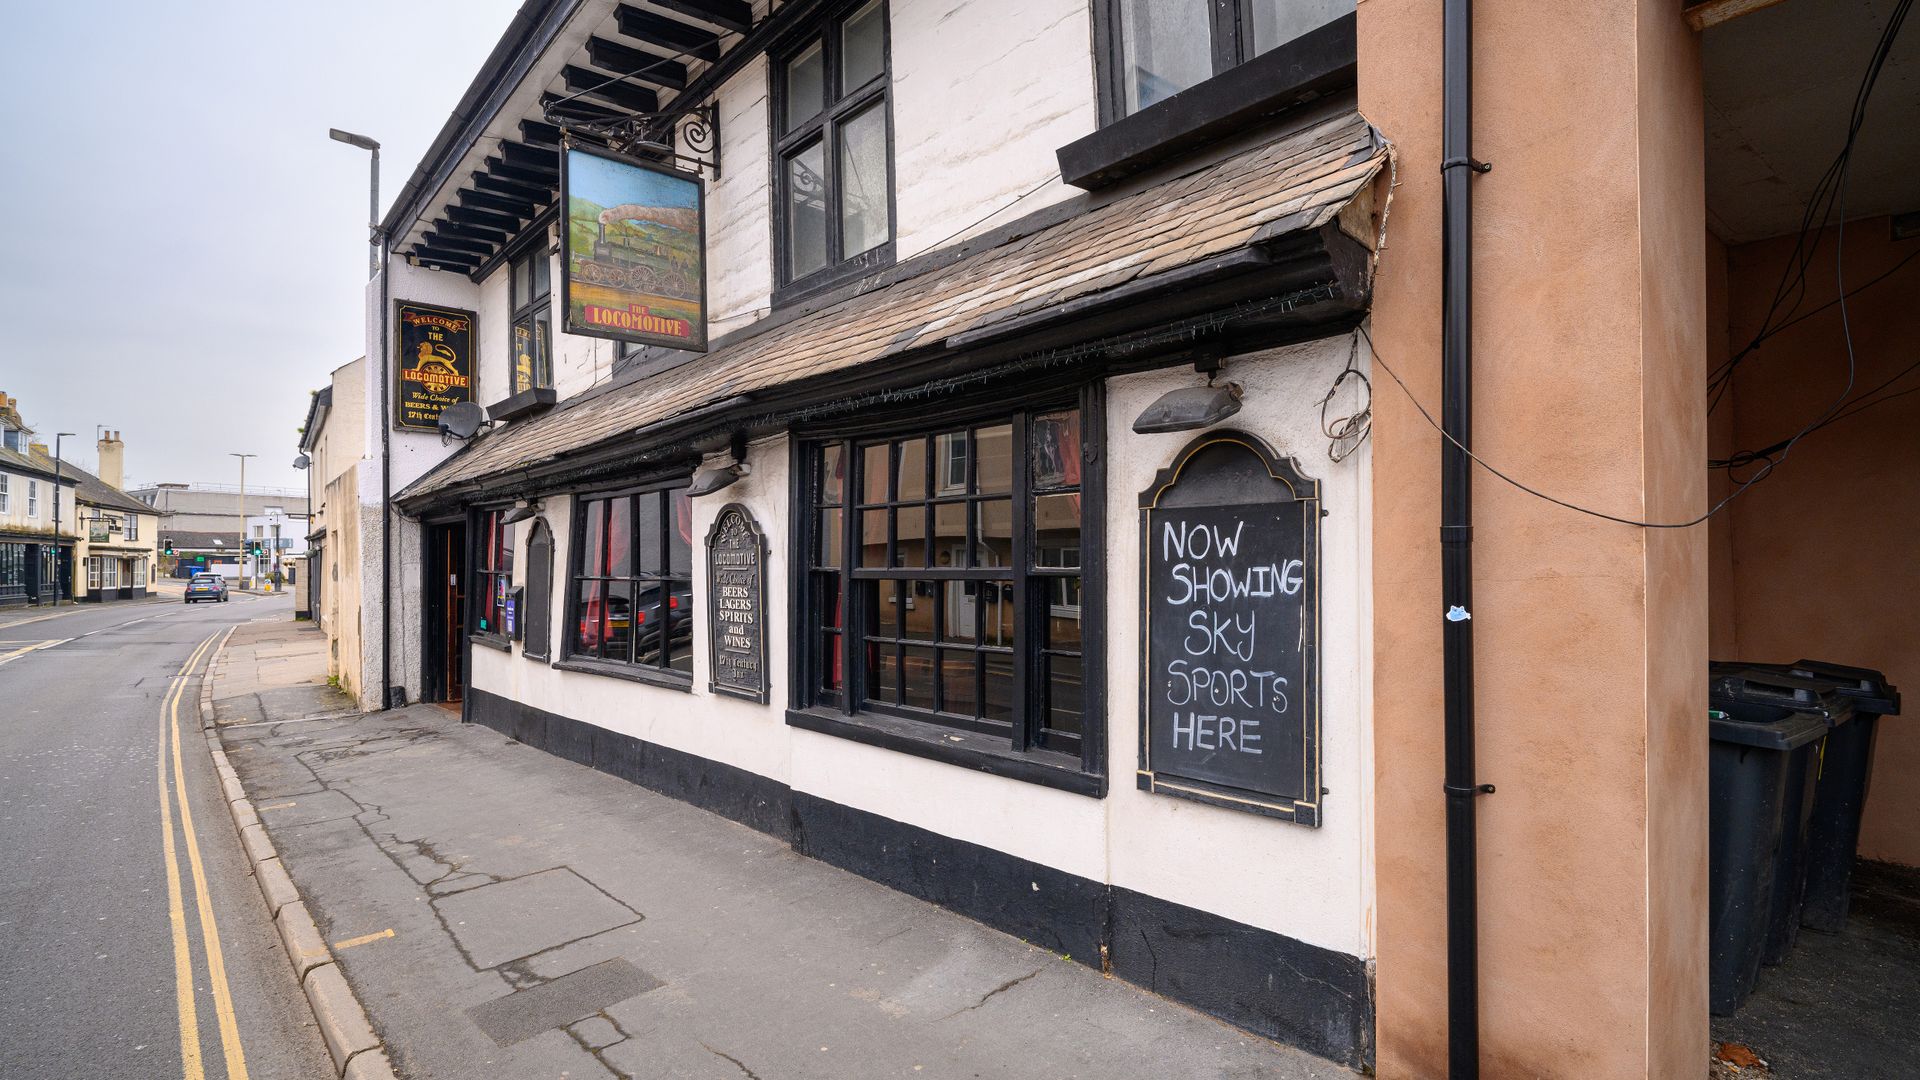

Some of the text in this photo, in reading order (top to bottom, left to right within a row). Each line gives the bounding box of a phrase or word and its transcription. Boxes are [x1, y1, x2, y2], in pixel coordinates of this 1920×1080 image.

[631, 305, 647, 314] THE
[413, 316, 459, 331] WELCOME
[593, 307, 682, 336] LOCOMOTIVE
[428, 332, 444, 342] THE
[404, 370, 466, 385] LOCOMOTIVE
[412, 391, 460, 405] Wide Choice of
[405, 401, 431, 409] BEERS
[408, 411, 423, 420] 17th
[720, 514, 751, 543] WELCOME
[731, 528, 738, 536] TO
[729, 538, 740, 549] THE
[1163, 520, 1244, 562] NOW
[715, 552, 756, 565] LOCOMOTIVE
[1166, 559, 1304, 605] SHOWING
[722, 586, 748, 598] BEERS
[719, 599, 752, 611] LAGERS
[719, 610, 753, 624] SPIRITS
[728, 625, 744, 635] and
[1184, 610, 1256, 662] SKY
[724, 635, 751, 648] WINES
[1167, 659, 1288, 713] SPORTS
[1173, 711, 1263, 754] HERE
